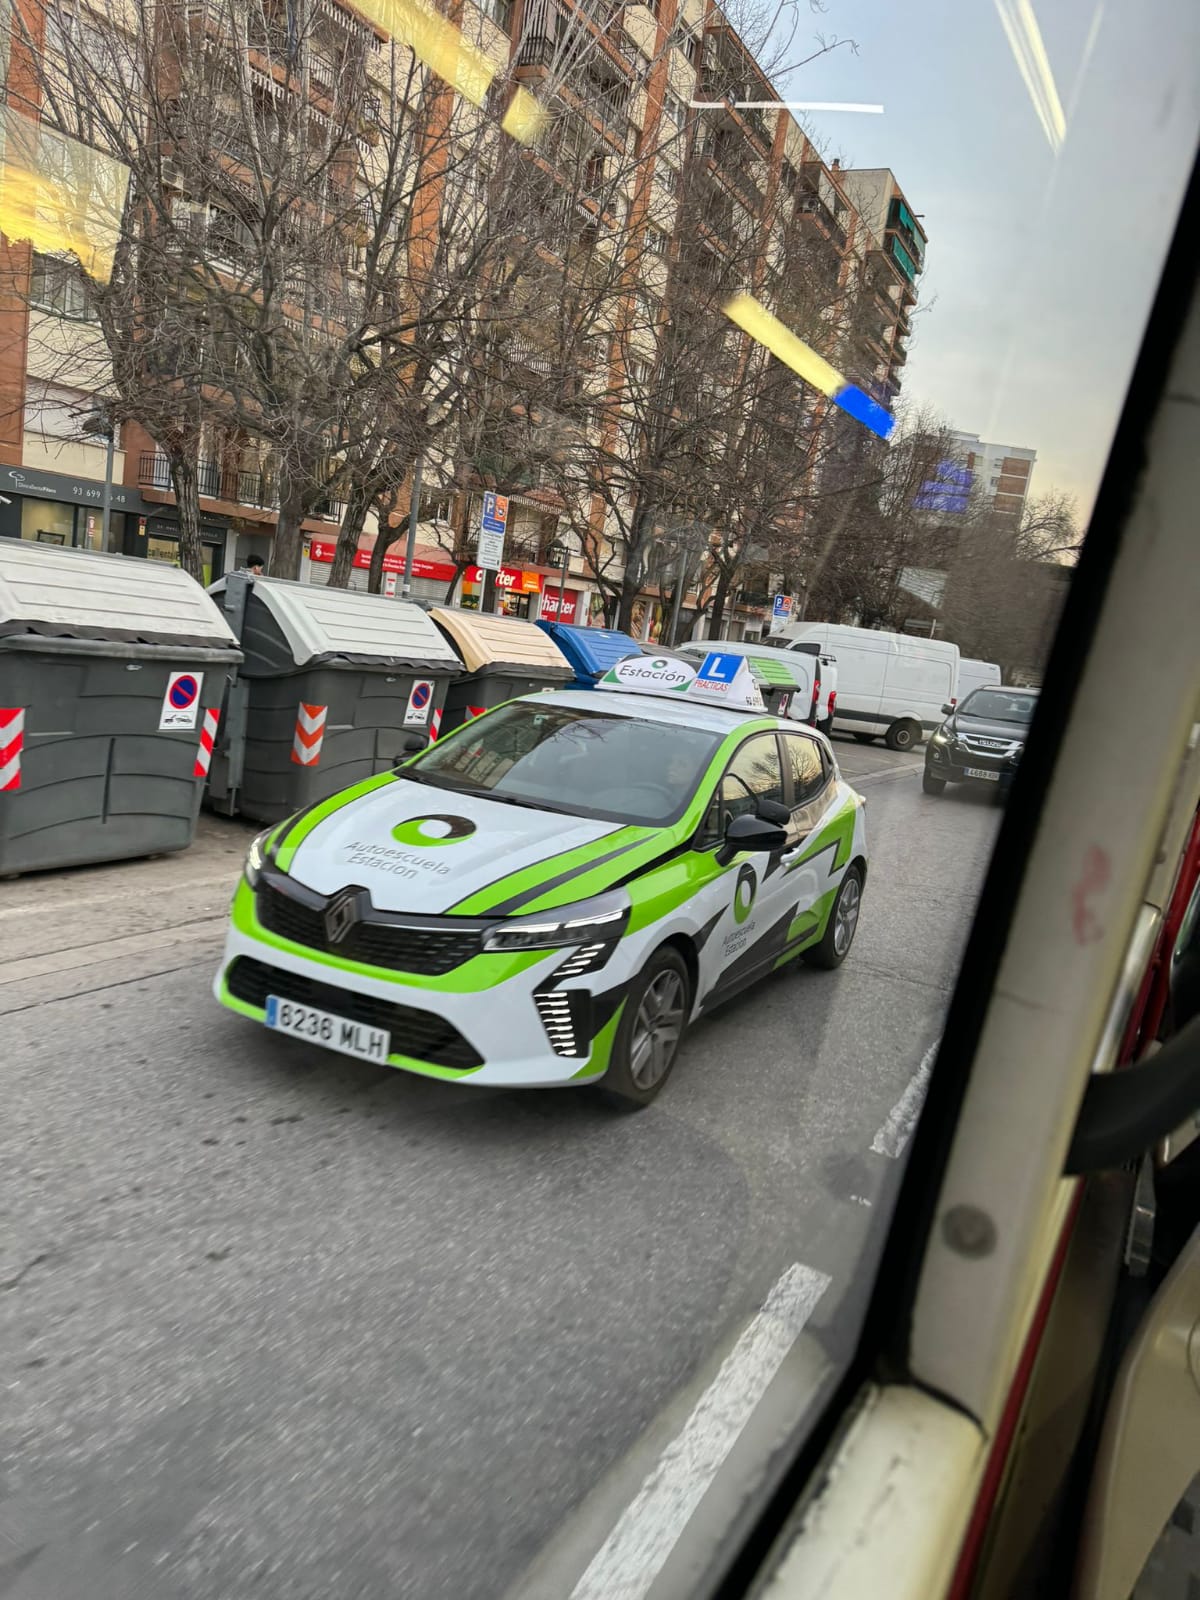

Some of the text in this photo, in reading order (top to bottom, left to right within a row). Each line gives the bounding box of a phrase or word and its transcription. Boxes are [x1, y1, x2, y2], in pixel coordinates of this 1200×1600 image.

[73, 486, 83, 496] 93
[486, 496, 495, 515] P
[618, 664, 686, 683] Estación
[707, 657, 726, 678] L
[343, 841, 451, 875] Autoescuela
[339, 1021, 385, 1058] MLH
